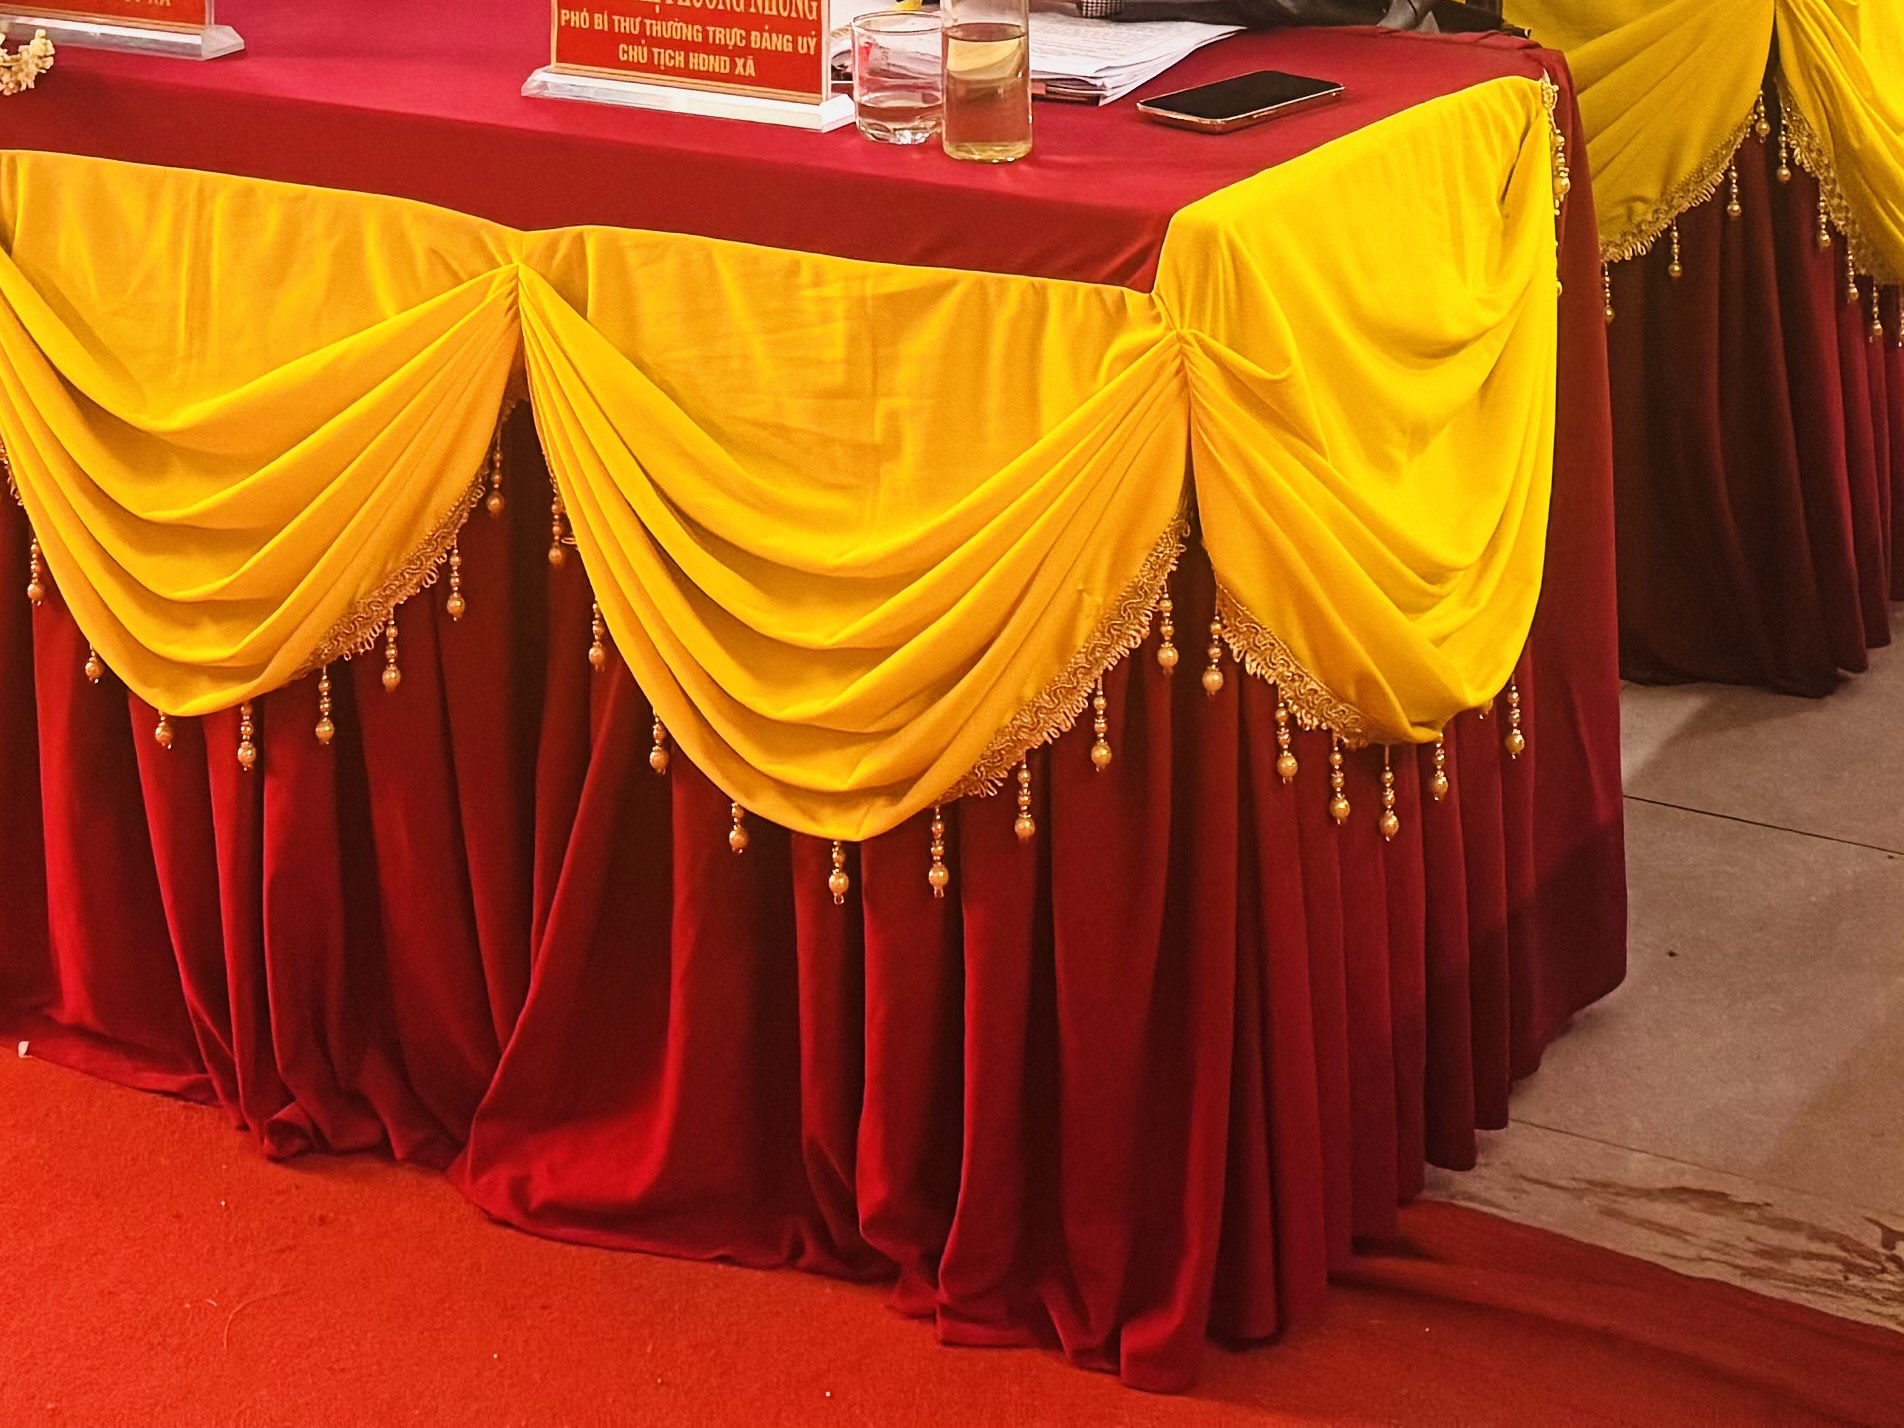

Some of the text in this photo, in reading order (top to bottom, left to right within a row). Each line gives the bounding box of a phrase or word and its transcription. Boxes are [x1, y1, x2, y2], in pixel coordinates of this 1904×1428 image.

[560, 6, 590, 29] PHÓ
[594, 9, 609, 32] BÍ
[611, 15, 642, 36] THƯ
[706, 26, 747, 50] TRỰC
[750, 24, 793, 53] ĐẢNG
[652, 48, 685, 71] TỊCH
